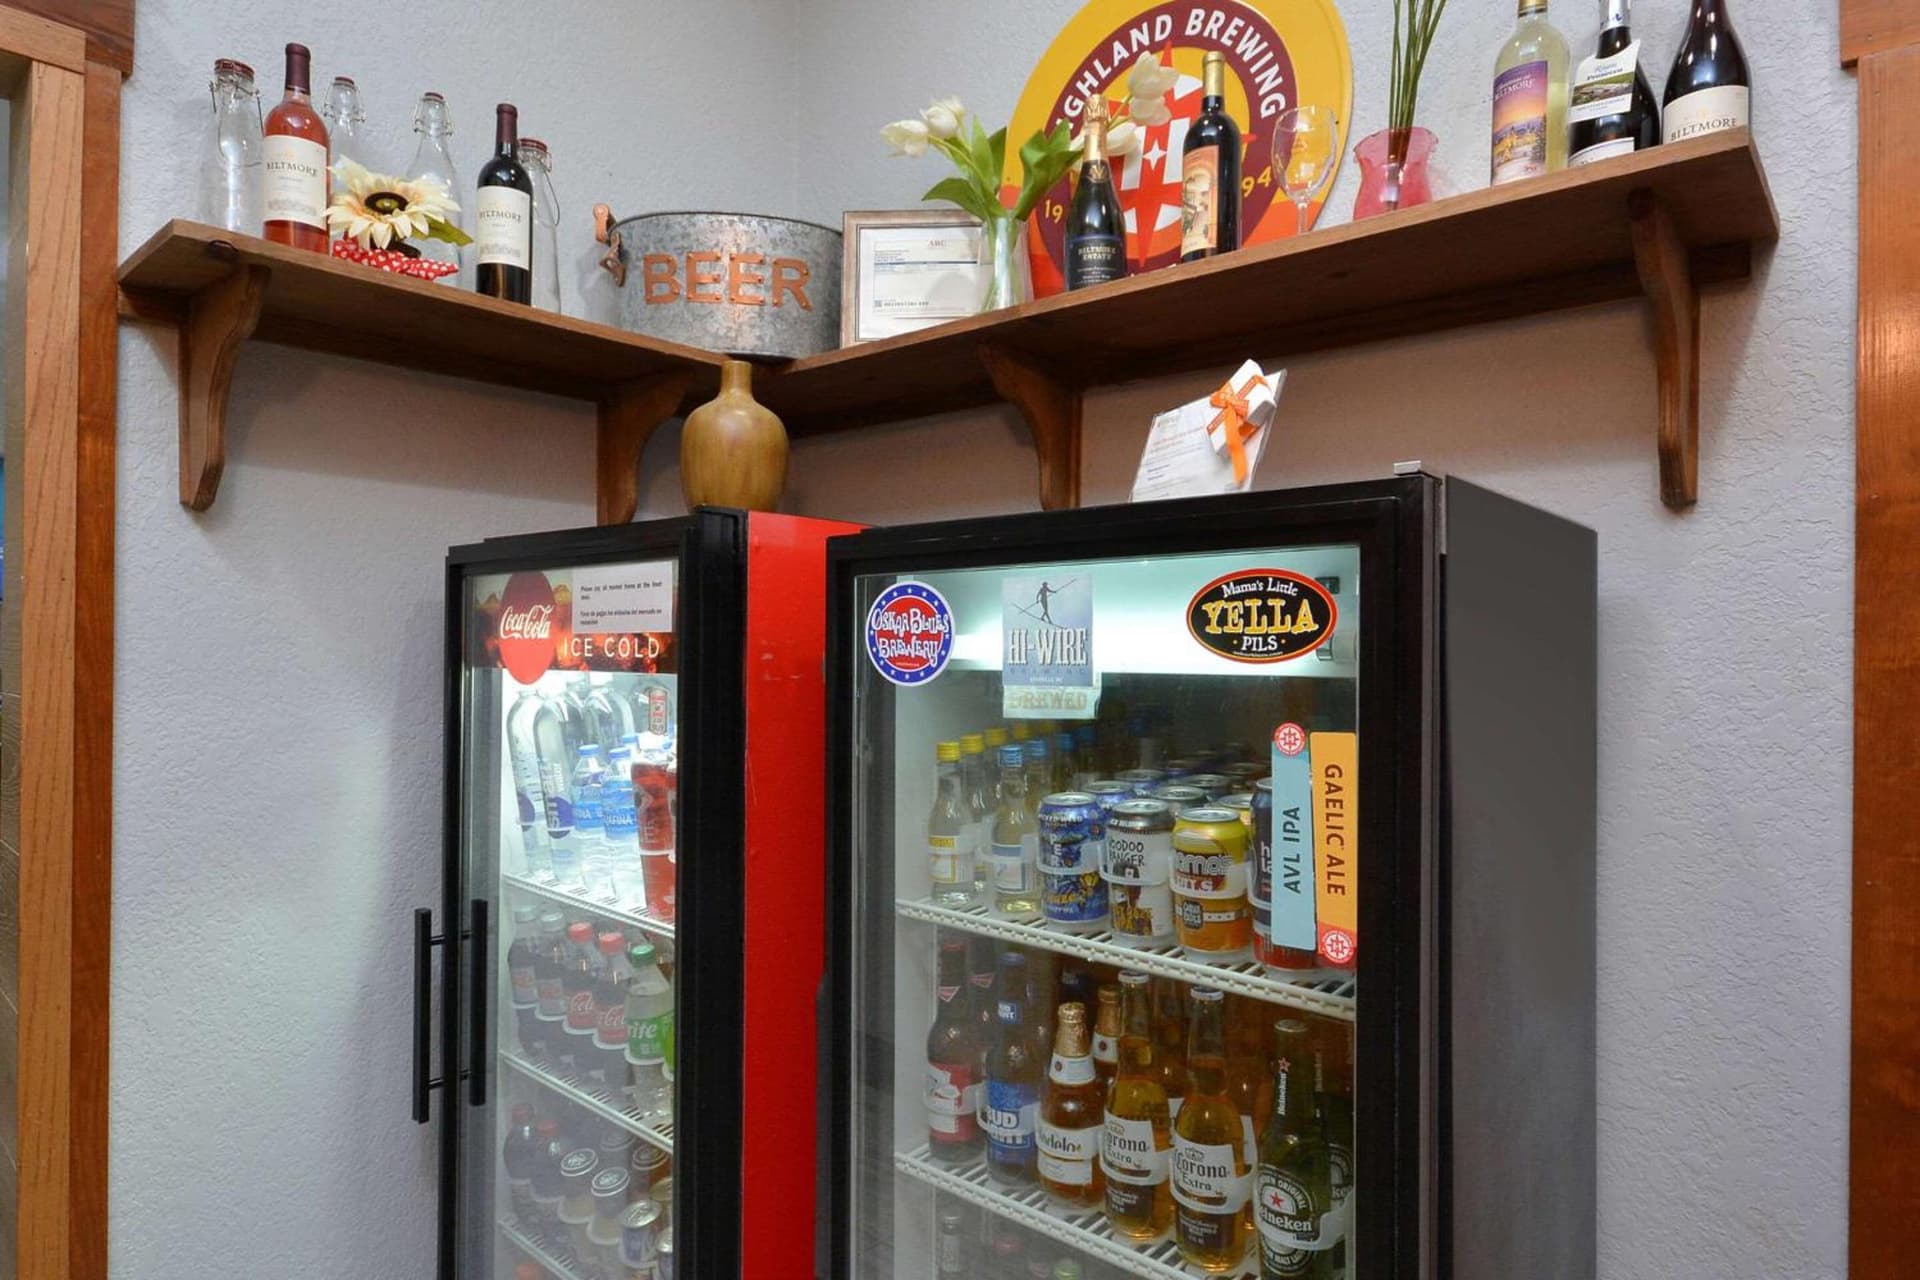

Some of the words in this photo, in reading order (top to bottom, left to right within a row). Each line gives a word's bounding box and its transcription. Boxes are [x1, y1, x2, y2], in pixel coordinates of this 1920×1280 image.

[1185, 8, 1287, 119] BREWING
[1671, 116, 1739, 141] BILTMORE
[1044, 199, 1064, 224] 19
[1241, 165, 1273, 198] 94
[643, 251, 814, 312] BEER
[1221, 579, 1265, 598] Mama's
[1266, 577, 1299, 596] Little
[500, 604, 553, 640] Coca-Cola
[1202, 598, 1320, 636] YELLA
[564, 637, 593, 658] ICE
[604, 637, 660, 658] COLD
[879, 635, 938, 668] BREWERY
[1008, 627, 1089, 666] HI-WIRE
[1241, 635, 1278, 651] PILS
[1324, 763, 1345, 846] GAELIC
[1282, 807, 1301, 843] IPA
[1283, 853, 1302, 895] AVL
[1326, 854, 1346, 896] ALE
[1176, 1150, 1228, 1179] Corona
[1182, 1171, 1212, 1192] Extra
